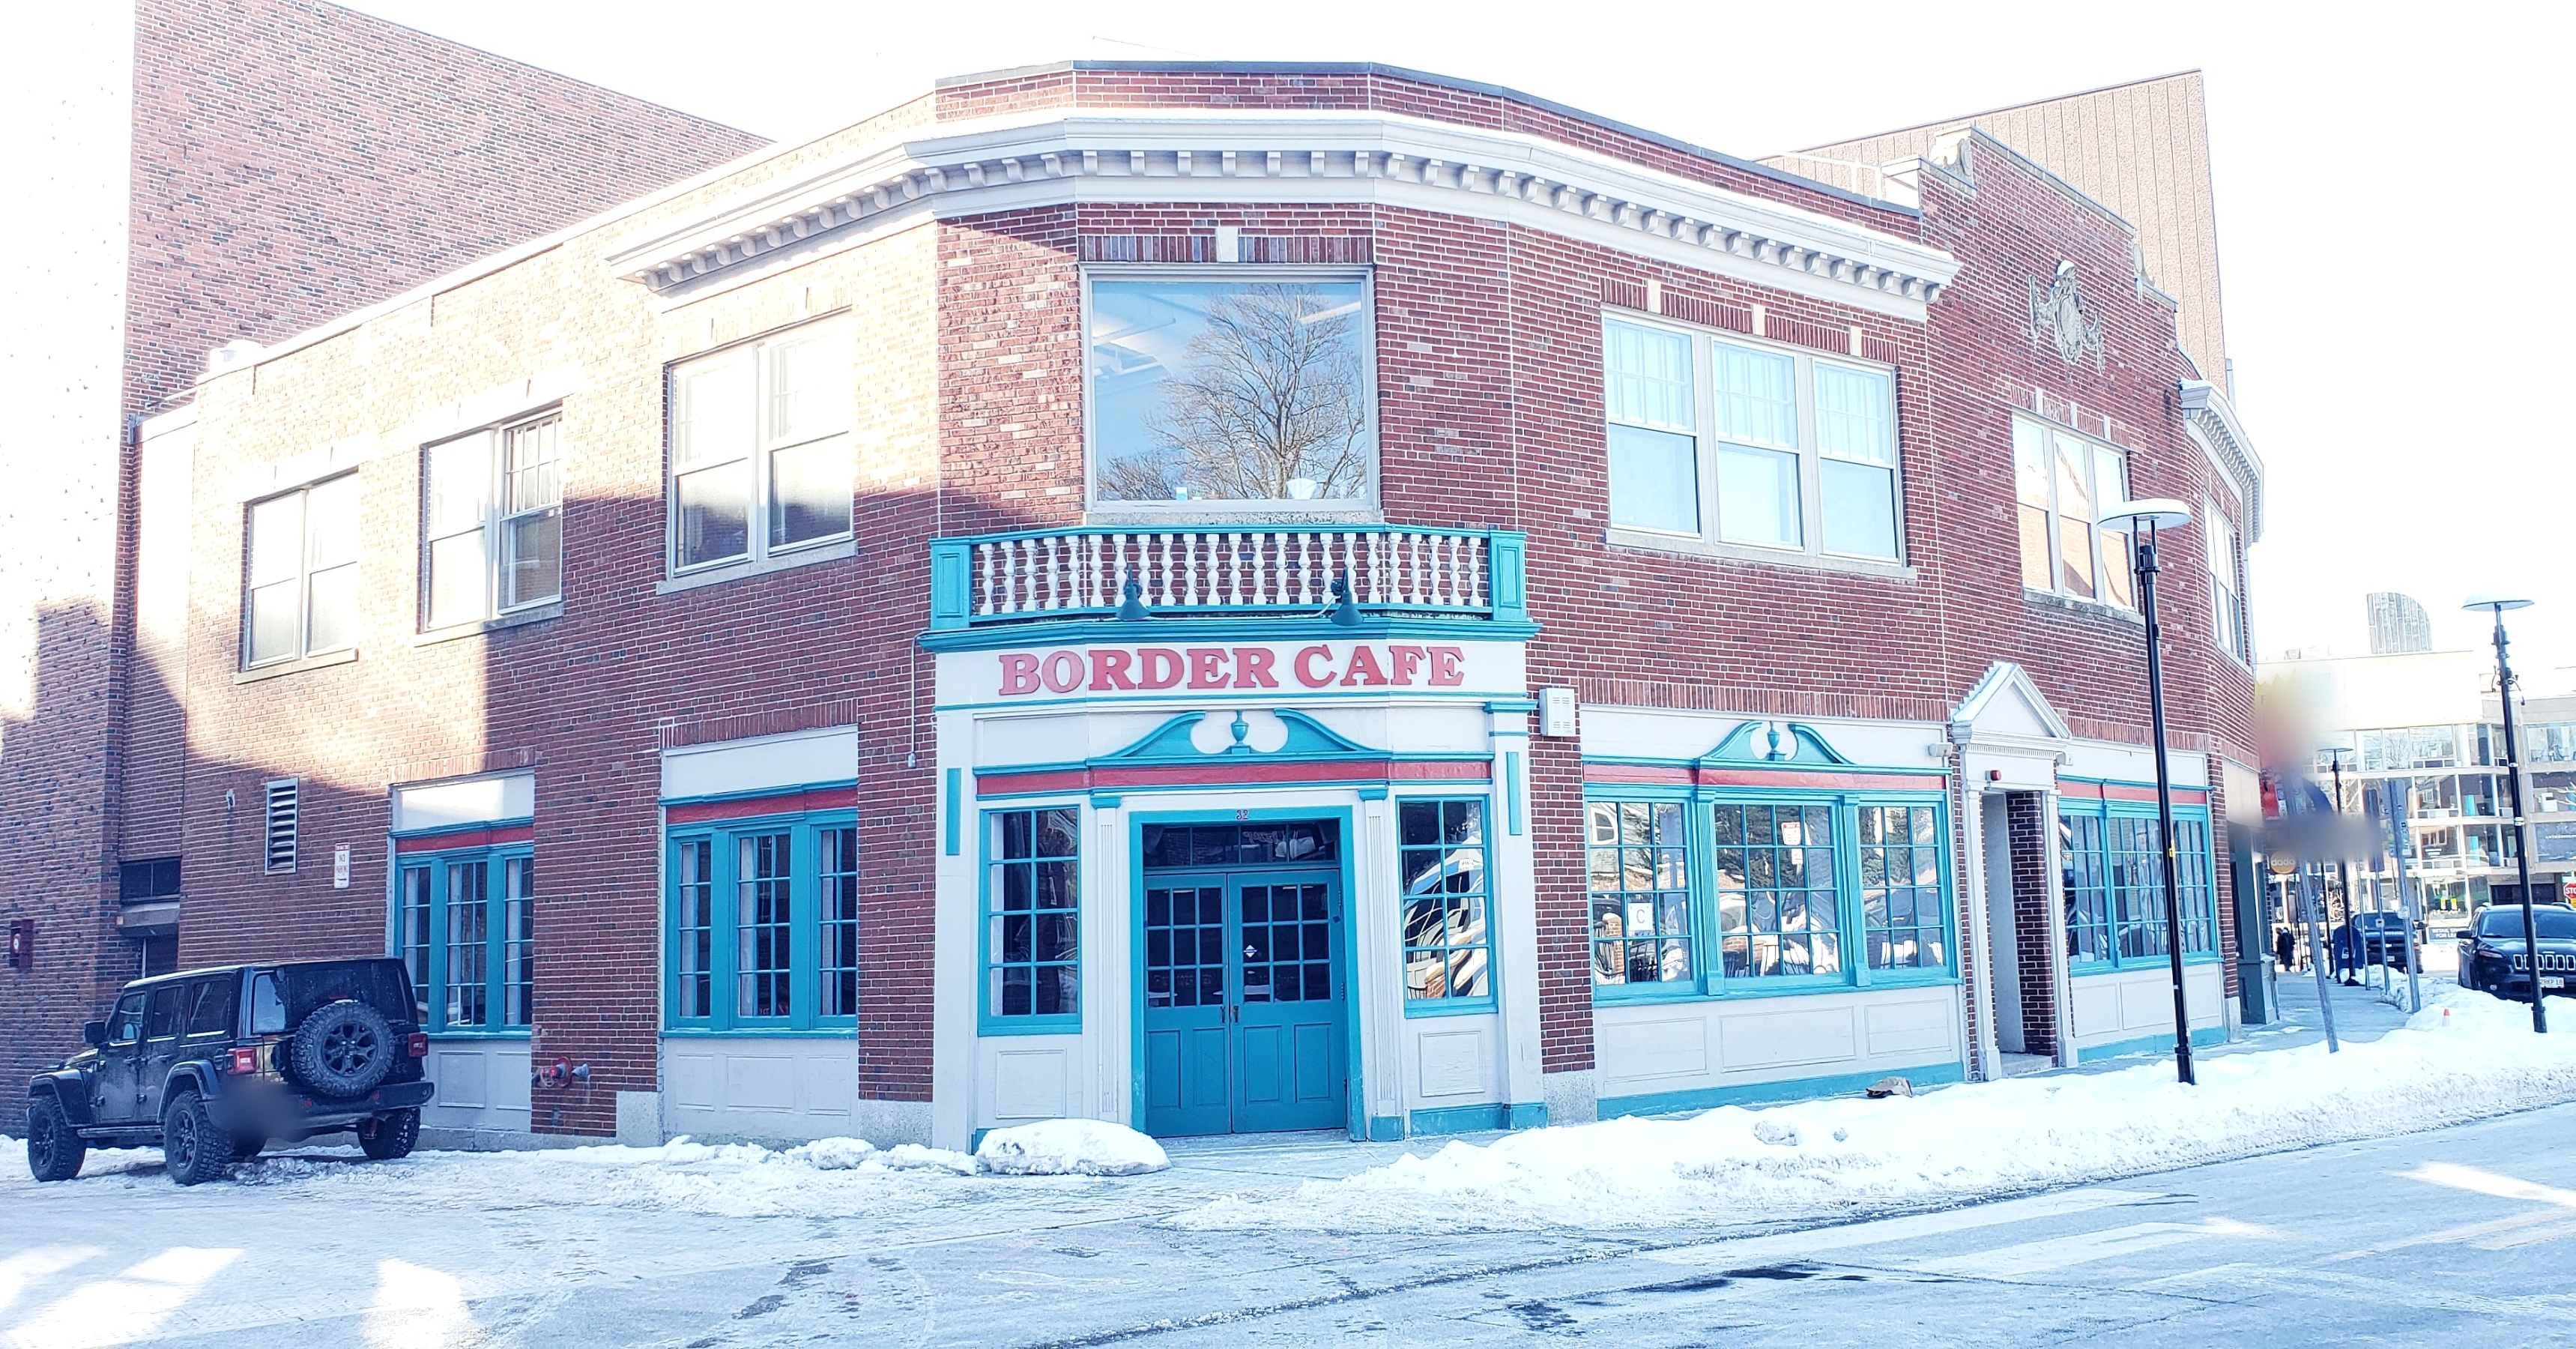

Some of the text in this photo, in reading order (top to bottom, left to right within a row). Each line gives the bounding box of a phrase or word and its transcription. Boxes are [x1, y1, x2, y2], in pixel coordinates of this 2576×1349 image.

[999, 644, 1466, 695] BORDER CAFE
[1236, 809, 1249, 821] 32
[339, 854, 345, 863] NO
[2270, 858, 2296, 866] dado
[2566, 887, 2576, 895] STO
